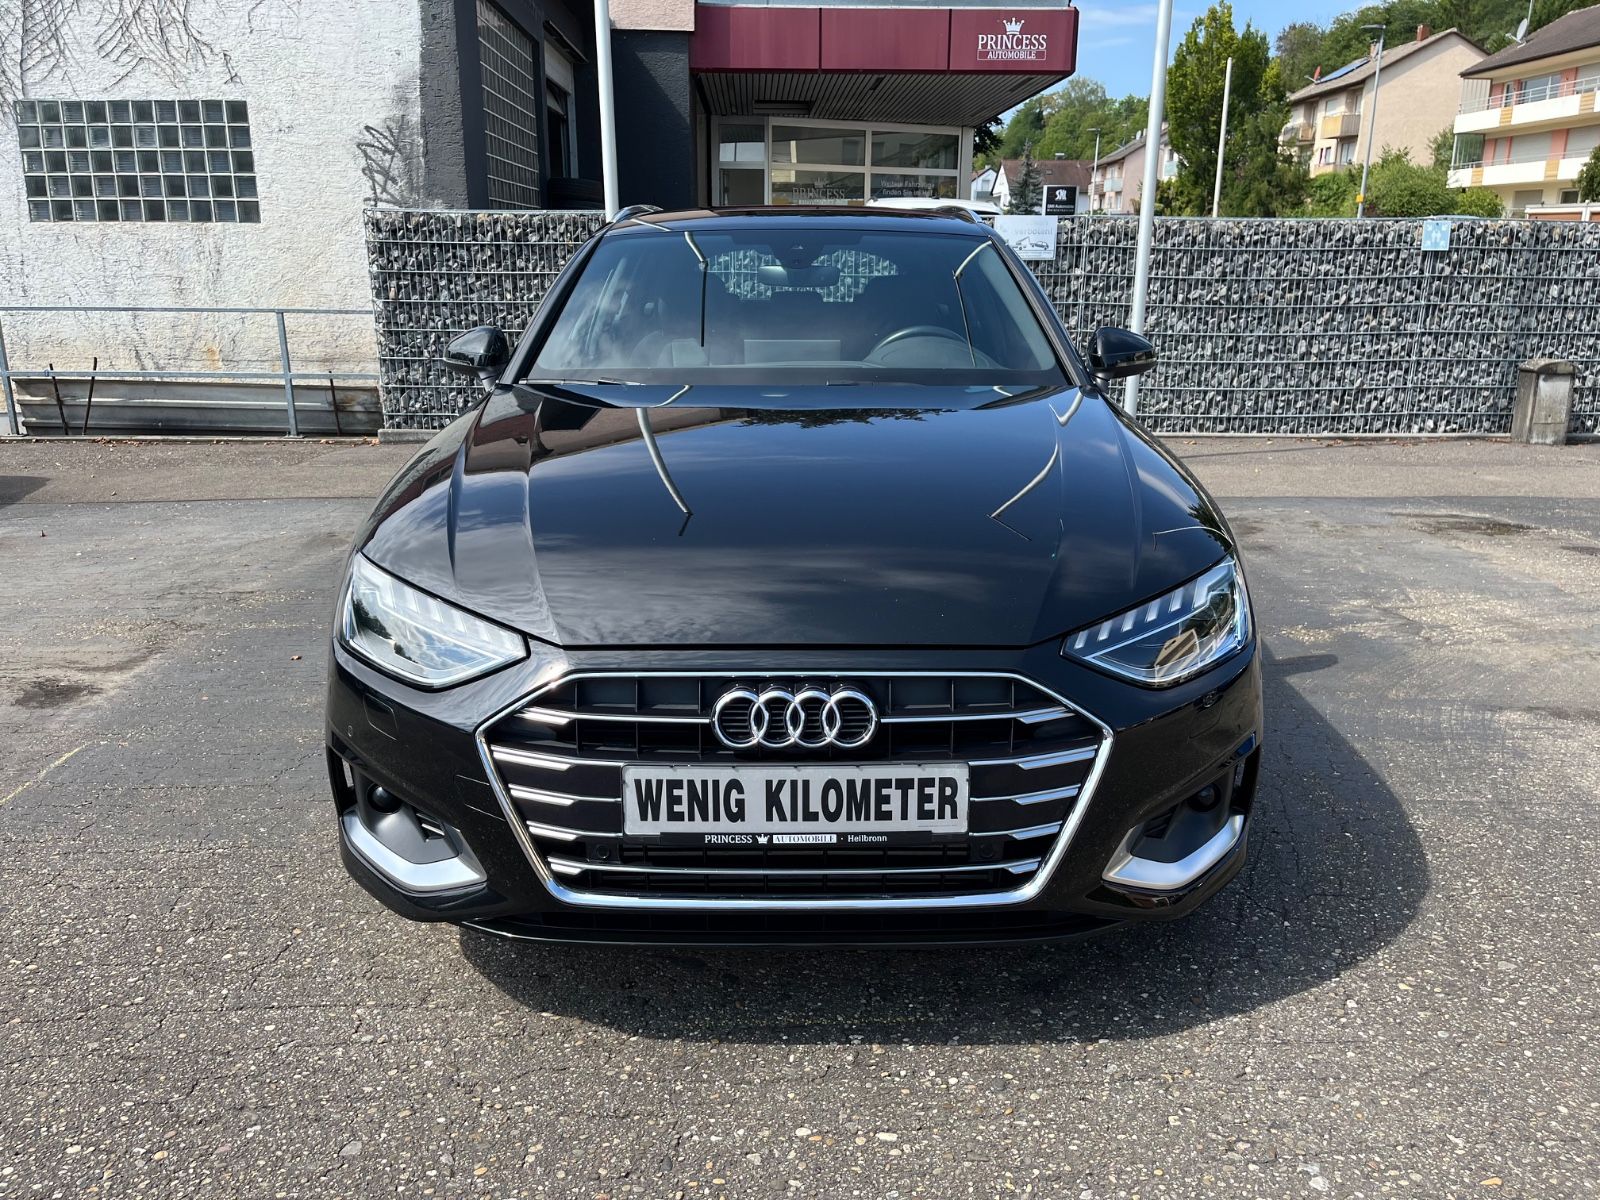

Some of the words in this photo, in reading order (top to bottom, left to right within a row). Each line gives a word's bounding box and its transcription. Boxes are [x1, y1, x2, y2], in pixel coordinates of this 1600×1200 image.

[978, 34, 1047, 50] PRINCESS
[987, 50, 1037, 59] AUTOMOBILE
[792, 187, 845, 199] PRINCESS
[634, 778, 746, 823] WENIG
[765, 777, 959, 823] KILOMETER
[704, 834, 753, 844] PRINCESS
[775, 834, 836, 844] AUTOMOBILE
[847, 834, 888, 843] Heilbronn
